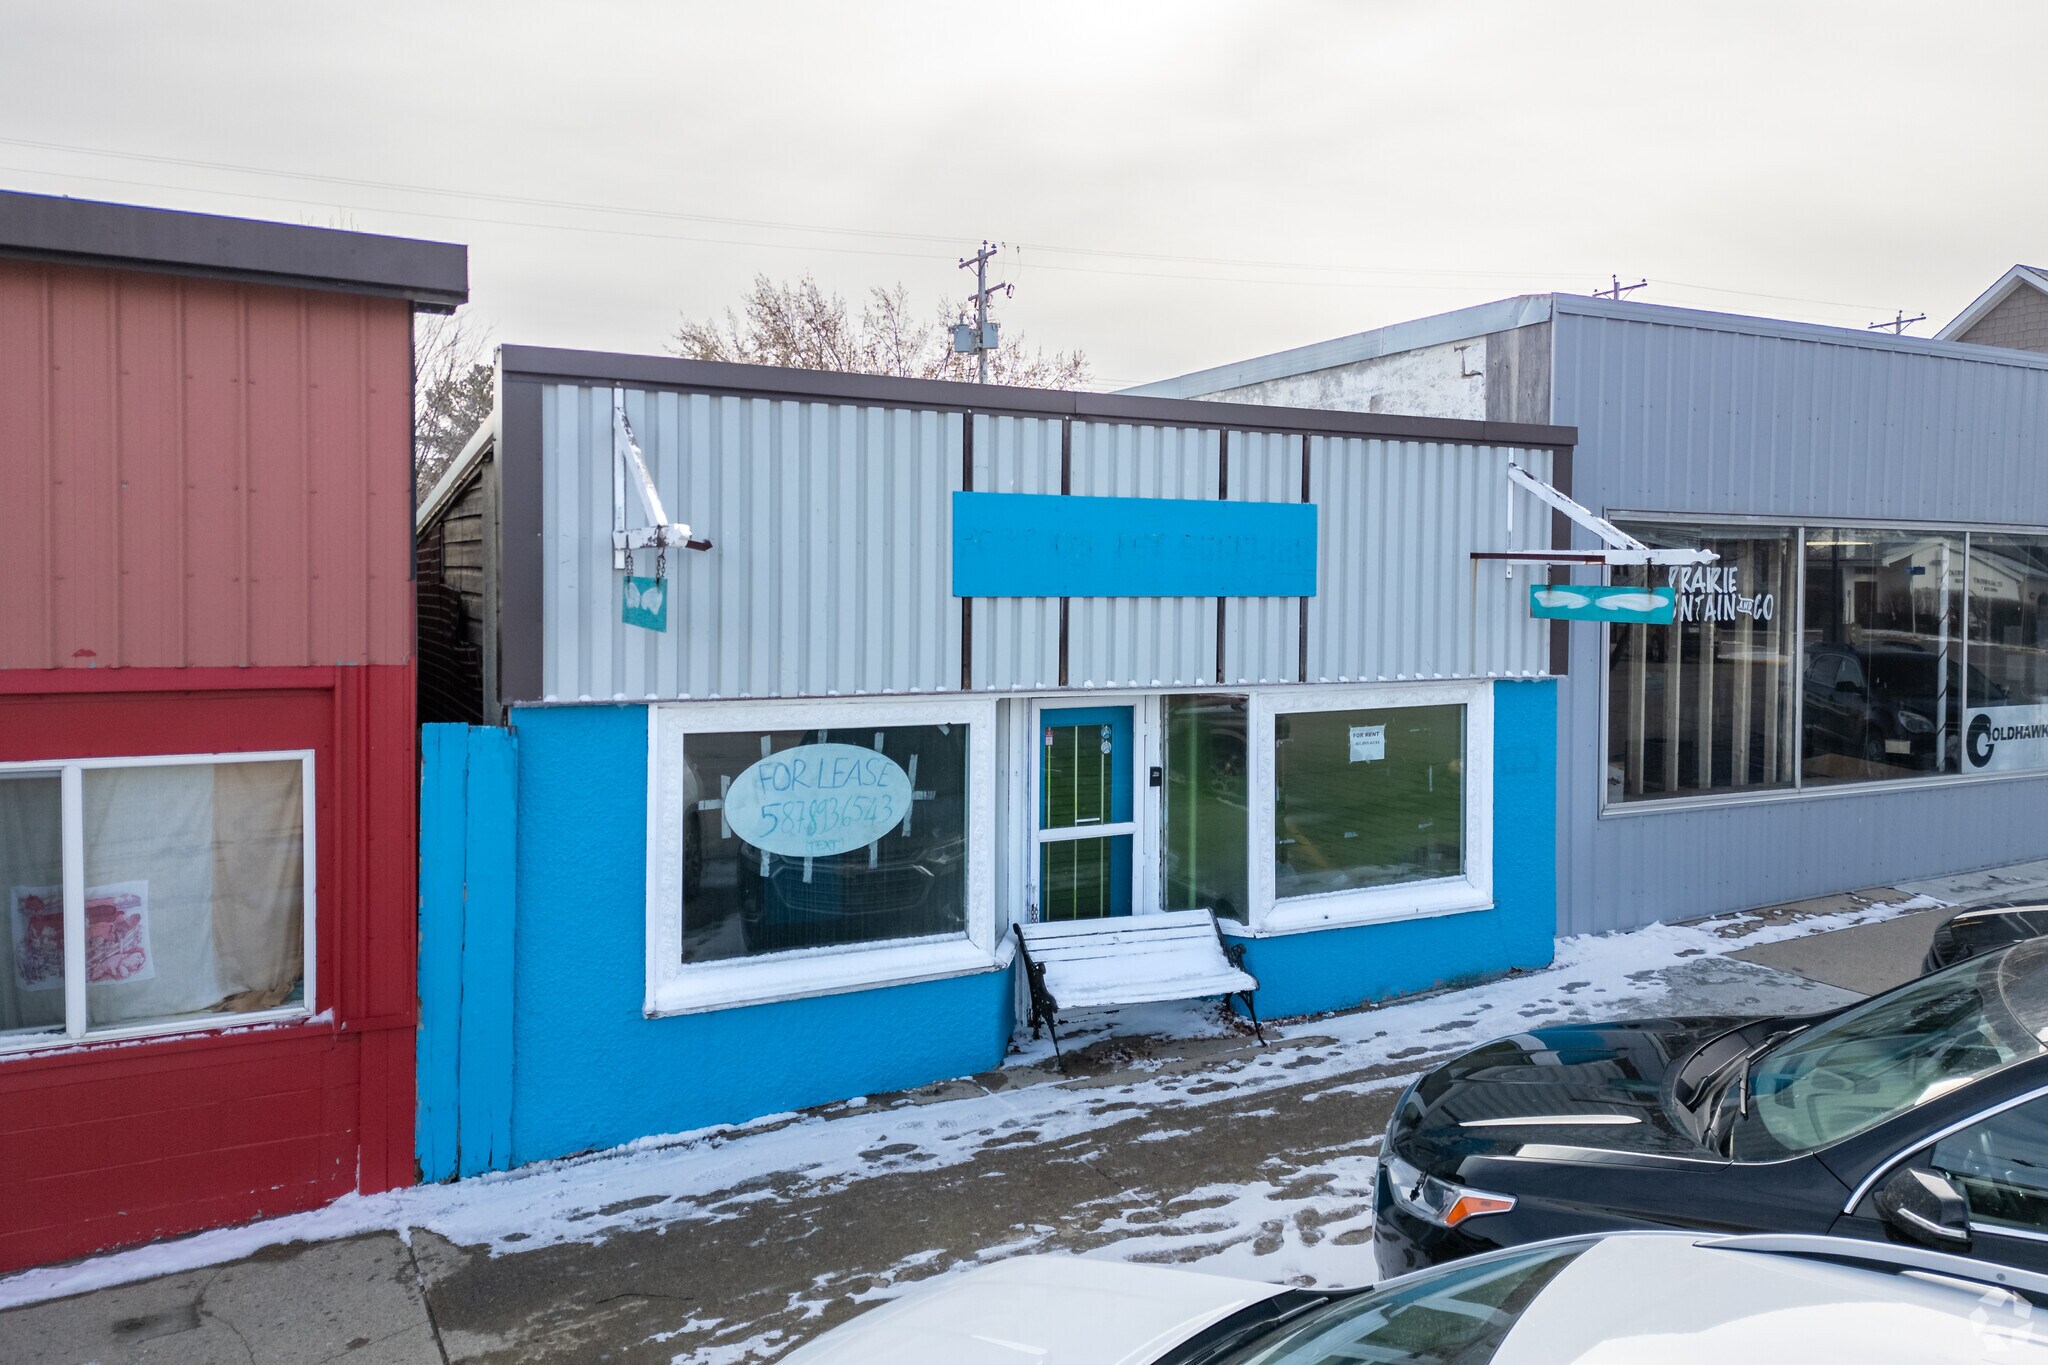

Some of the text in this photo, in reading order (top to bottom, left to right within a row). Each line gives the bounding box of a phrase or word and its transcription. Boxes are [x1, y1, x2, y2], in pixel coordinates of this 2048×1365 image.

[1668, 566, 1738, 593] PRAIRIE
[1673, 594, 1736, 621] NTAIN
[1753, 593, 1774, 620] CO
[758, 757, 896, 795] FOR LEASE
